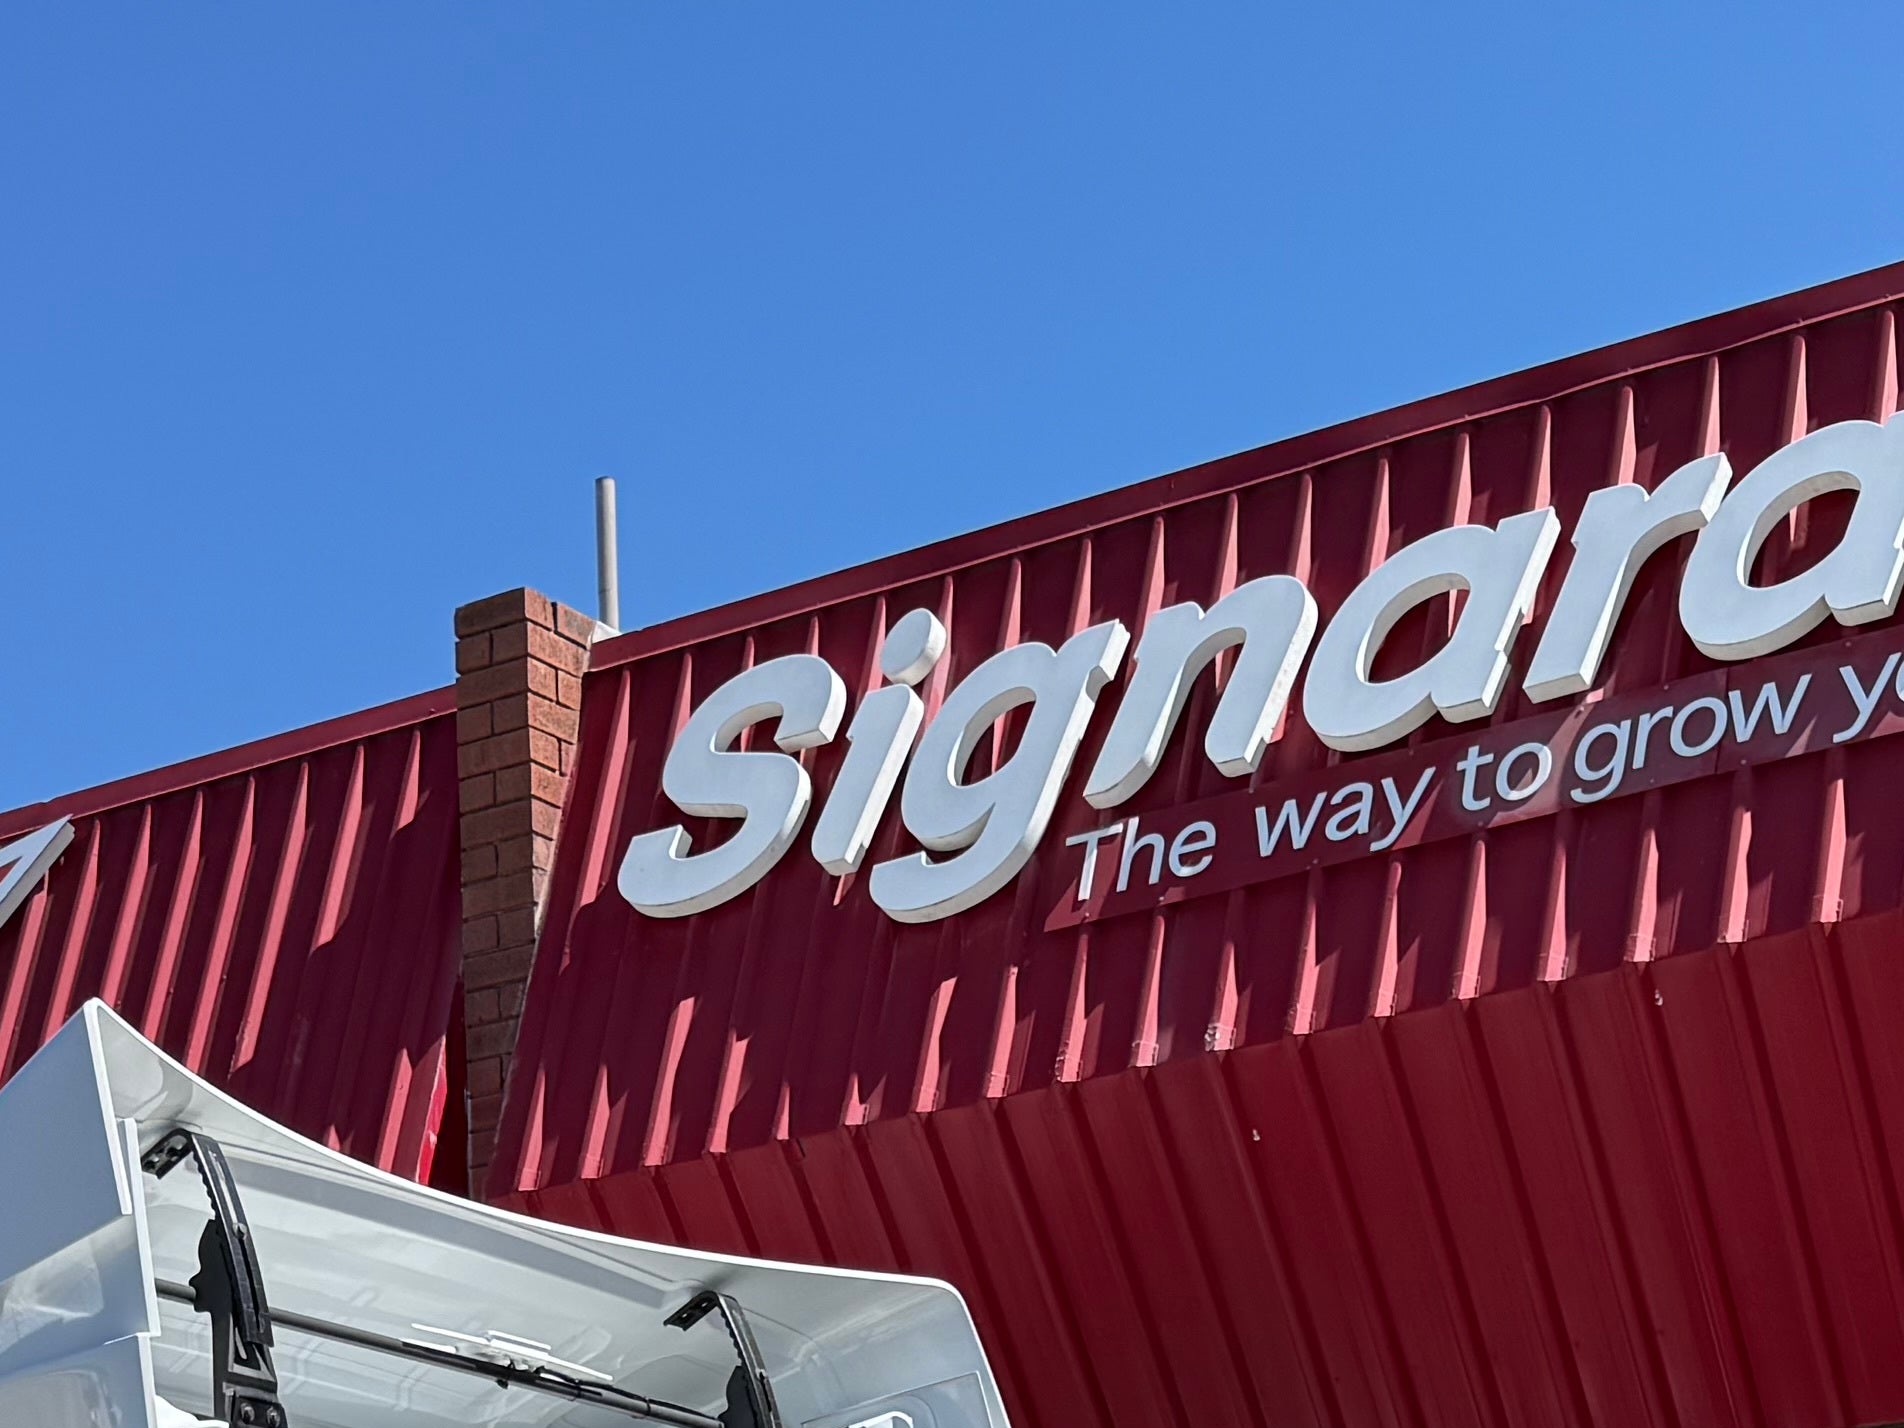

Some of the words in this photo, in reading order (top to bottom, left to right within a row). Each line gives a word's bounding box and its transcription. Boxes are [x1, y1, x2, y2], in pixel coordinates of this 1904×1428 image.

[1065, 816, 1216, 902] The
[1254, 765, 1435, 858] way
[1456, 740, 1551, 813] to
[1570, 673, 1811, 804] grow
